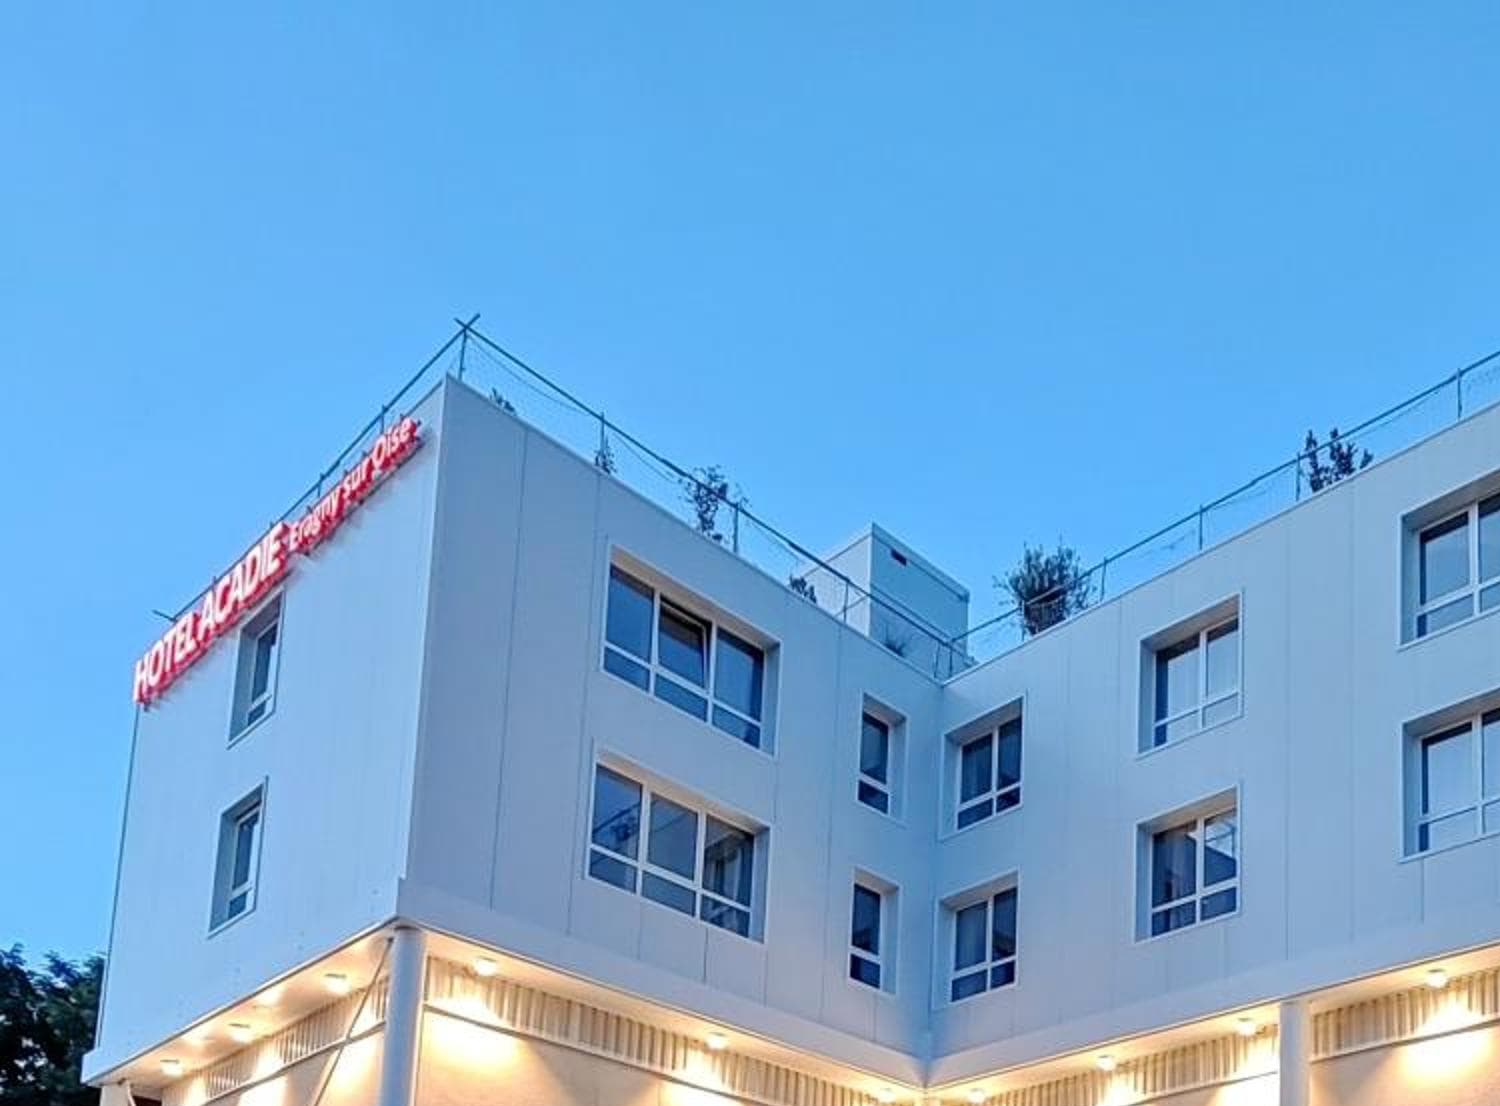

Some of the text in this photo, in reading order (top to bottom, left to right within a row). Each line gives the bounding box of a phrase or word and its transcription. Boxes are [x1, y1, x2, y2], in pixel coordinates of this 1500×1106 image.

[133, 611, 198, 704] HOTEL
[197, 520, 288, 643] ACADIE
[342, 455, 373, 499] sur
[373, 417, 417, 469] Oise
